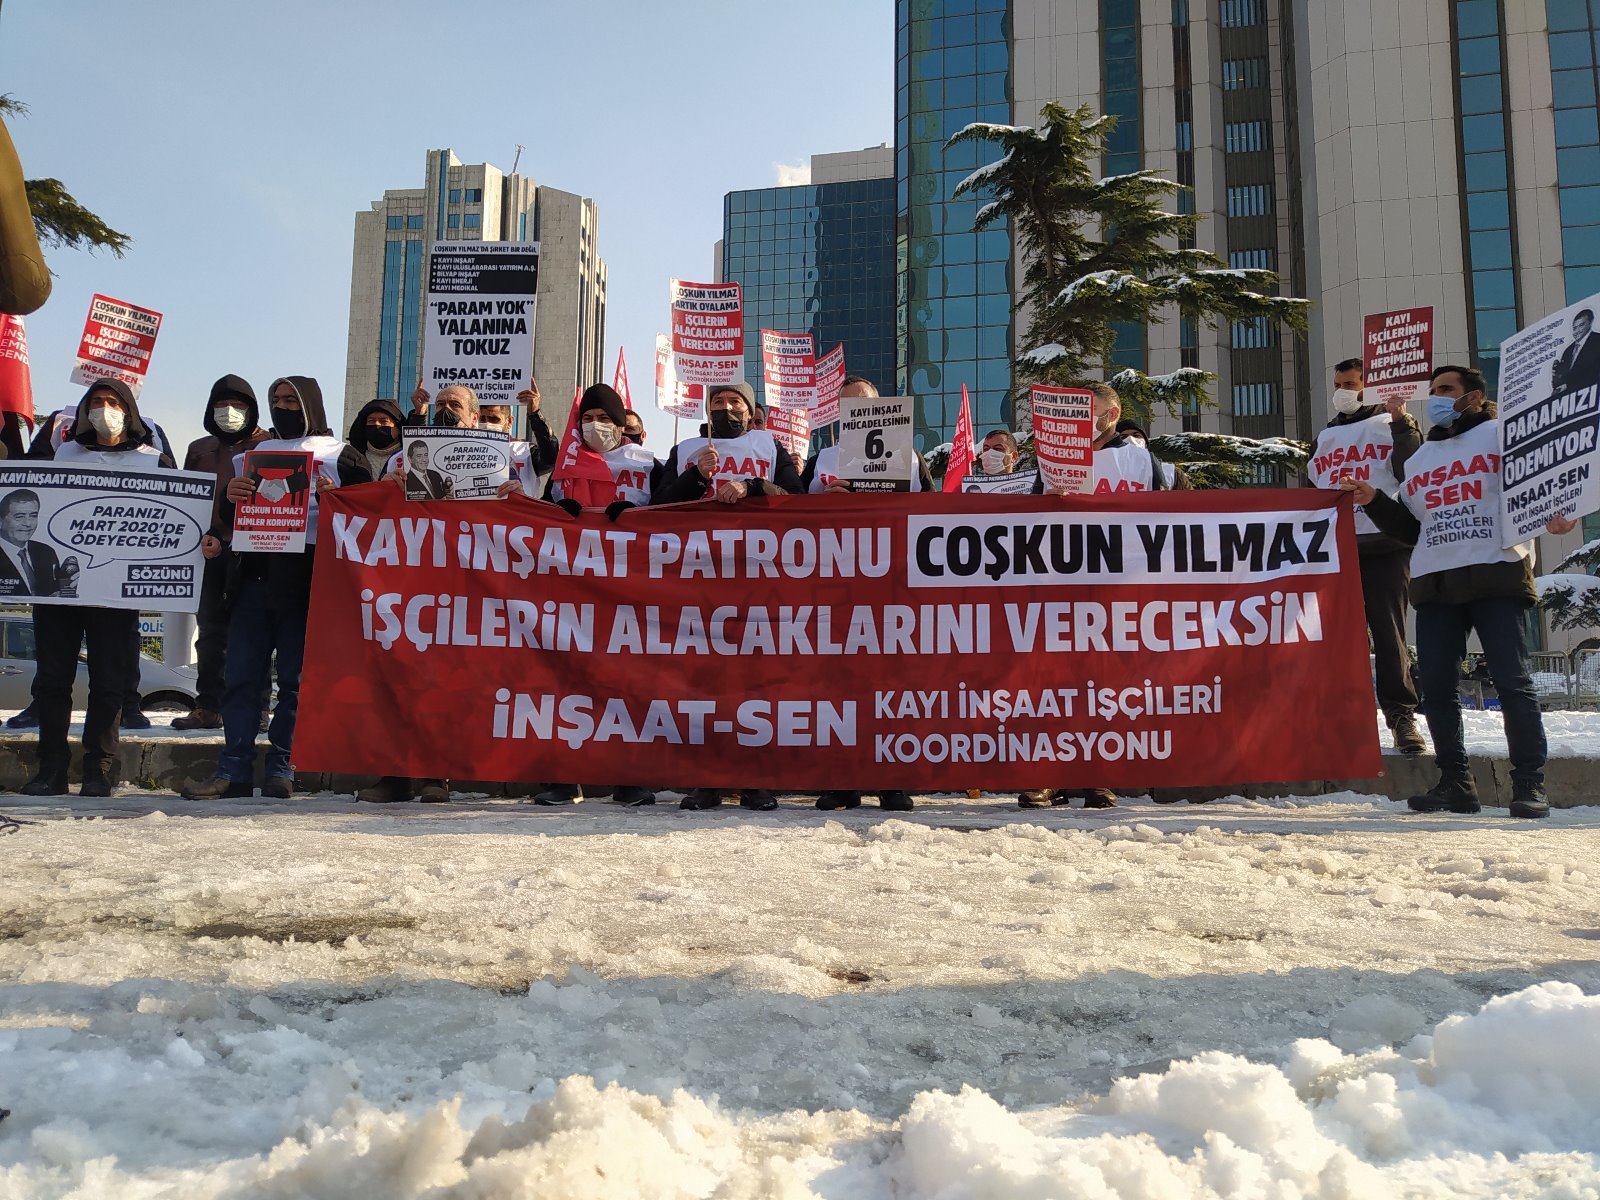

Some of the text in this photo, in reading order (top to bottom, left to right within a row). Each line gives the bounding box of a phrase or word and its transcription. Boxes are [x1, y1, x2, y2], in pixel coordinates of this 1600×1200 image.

[707, 289, 737, 299] YILMAZ
[95, 300, 158, 325] COŞKUN YILMAZ
[675, 300, 739, 311] ARTIK OYALAMA
[92, 311, 155, 336] ARTIK OYALAMA
[437, 318, 527, 336] YALANINA
[685, 314, 728, 327] İŞÇİLERİN
[1385, 313, 1411, 327] KAYI
[674, 323, 741, 339] ALACAKLARINI
[1368, 321, 1429, 345] İŞÇİLERİNİN
[84, 333, 150, 360] ALACAKLARINI
[452, 338, 510, 356] TOKUZ
[680, 337, 735, 351] VERECEKSİN
[765, 345, 812, 355] ARTIK OYALAMA
[787, 338, 810, 346] YILMAZ
[1376, 335, 1420, 356] ALACAĞI
[88, 345, 140, 368] VERECEKSİN
[678, 357, 738, 369] İNŞAAT-SEN
[1370, 348, 1425, 369] HEPİMİZİN
[1367, 362, 1429, 383] ALACAĞIDIR
[485, 381, 516, 391] İŞÇİLERİ
[1034, 392, 1089, 405] COŞKUN YILMAZ
[850, 408, 870, 418] KAYI
[872, 404, 902, 416] İNŞAAT
[1034, 405, 1089, 419] ARTIK OYALAMA
[1506, 384, 1598, 446] PARAMIZI
[842, 414, 910, 430] MÜCADELESİNİN
[1042, 419, 1078, 434] İŞÇİLERİN
[865, 429, 893, 460] 6.
[1035, 430, 1090, 448] ALACAKLARINI
[466, 454, 498, 462] 2020'DE
[1039, 443, 1084, 460] VERECEKSİN
[1505, 425, 1595, 486] ÖDEMİYOR
[445, 460, 497, 470] ÖDEYECEĞİM
[863, 461, 887, 473] GÜNÜ
[1, 470, 211, 497] KAYI İNŞAAT PATRONU COŞKUN YILMAZ
[457, 488, 479, 498] SÖZÜNÜ
[1424, 480, 1482, 510] SEN
[92, 505, 167, 520] PARANIZI
[241, 506, 270, 515] COŞKUN
[1512, 512, 1528, 525] KAYI
[69, 519, 186, 536] MART 2020'DE
[237, 516, 304, 527] KİMLER KORUYOR?
[71, 530, 180, 550] ÖDEYECEĞİM
[332, 511, 447, 568] KAYI
[649, 527, 890, 579] PATRONU
[916, 523, 1123, 581] COŞKUN
[1136, 517, 1330, 574] YILMAZ
[1426, 529, 1493, 548] SENDİKASI
[131, 566, 192, 581] SÖZÜNÜ
[125, 584, 191, 597] TUTMADI
[606, 603, 990, 655] ALACAKLARINI
[876, 676, 1222, 722] KAYI İNŞAAT İŞÇİLERİ
[876, 725, 1172, 763] KOORDİNASYONU
